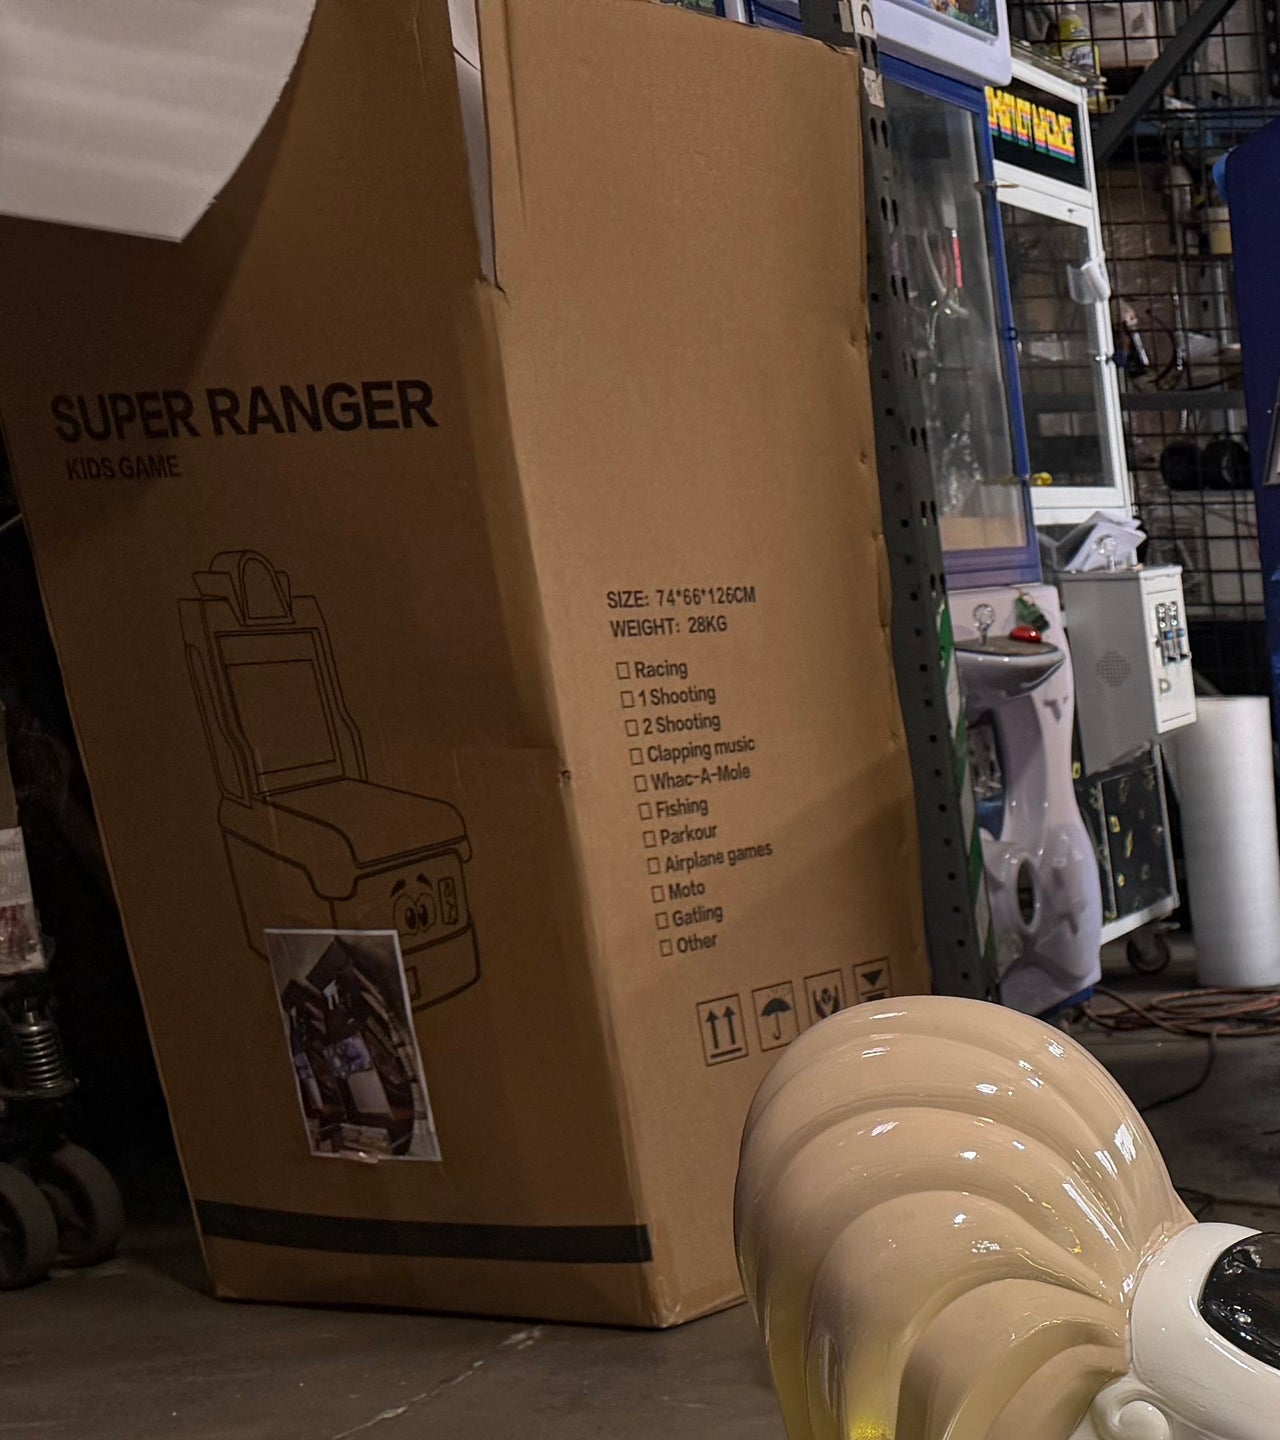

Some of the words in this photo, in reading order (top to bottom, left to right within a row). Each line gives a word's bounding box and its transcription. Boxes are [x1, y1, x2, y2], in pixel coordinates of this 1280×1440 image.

[51, 390, 201, 443] SUPER
[205, 379, 439, 437] RANGER
[66, 456, 116, 481] KIDS
[119, 454, 182, 479] GAME
[607, 590, 649, 609] SIZE:
[610, 617, 681, 638] WEIGHT:
[687, 615, 728, 635] 28KG
[634, 660, 688, 679] Racing
[649, 686, 716, 706] Shooting
[643, 717, 653, 735] 2
[656, 712, 721, 734] Shooting
[647, 741, 713, 764] Clapping
[714, 736, 756, 756] music
[651, 763, 751, 791] Whac-A-Mole
[656, 798, 709, 819] Fishing
[660, 823, 718, 847] Parkour
[665, 850, 725, 874] Airplane
[728, 843, 774, 865] games
[668, 880, 706, 900] Moto
[672, 903, 724, 928] Gatling
[677, 931, 718, 955] Other
